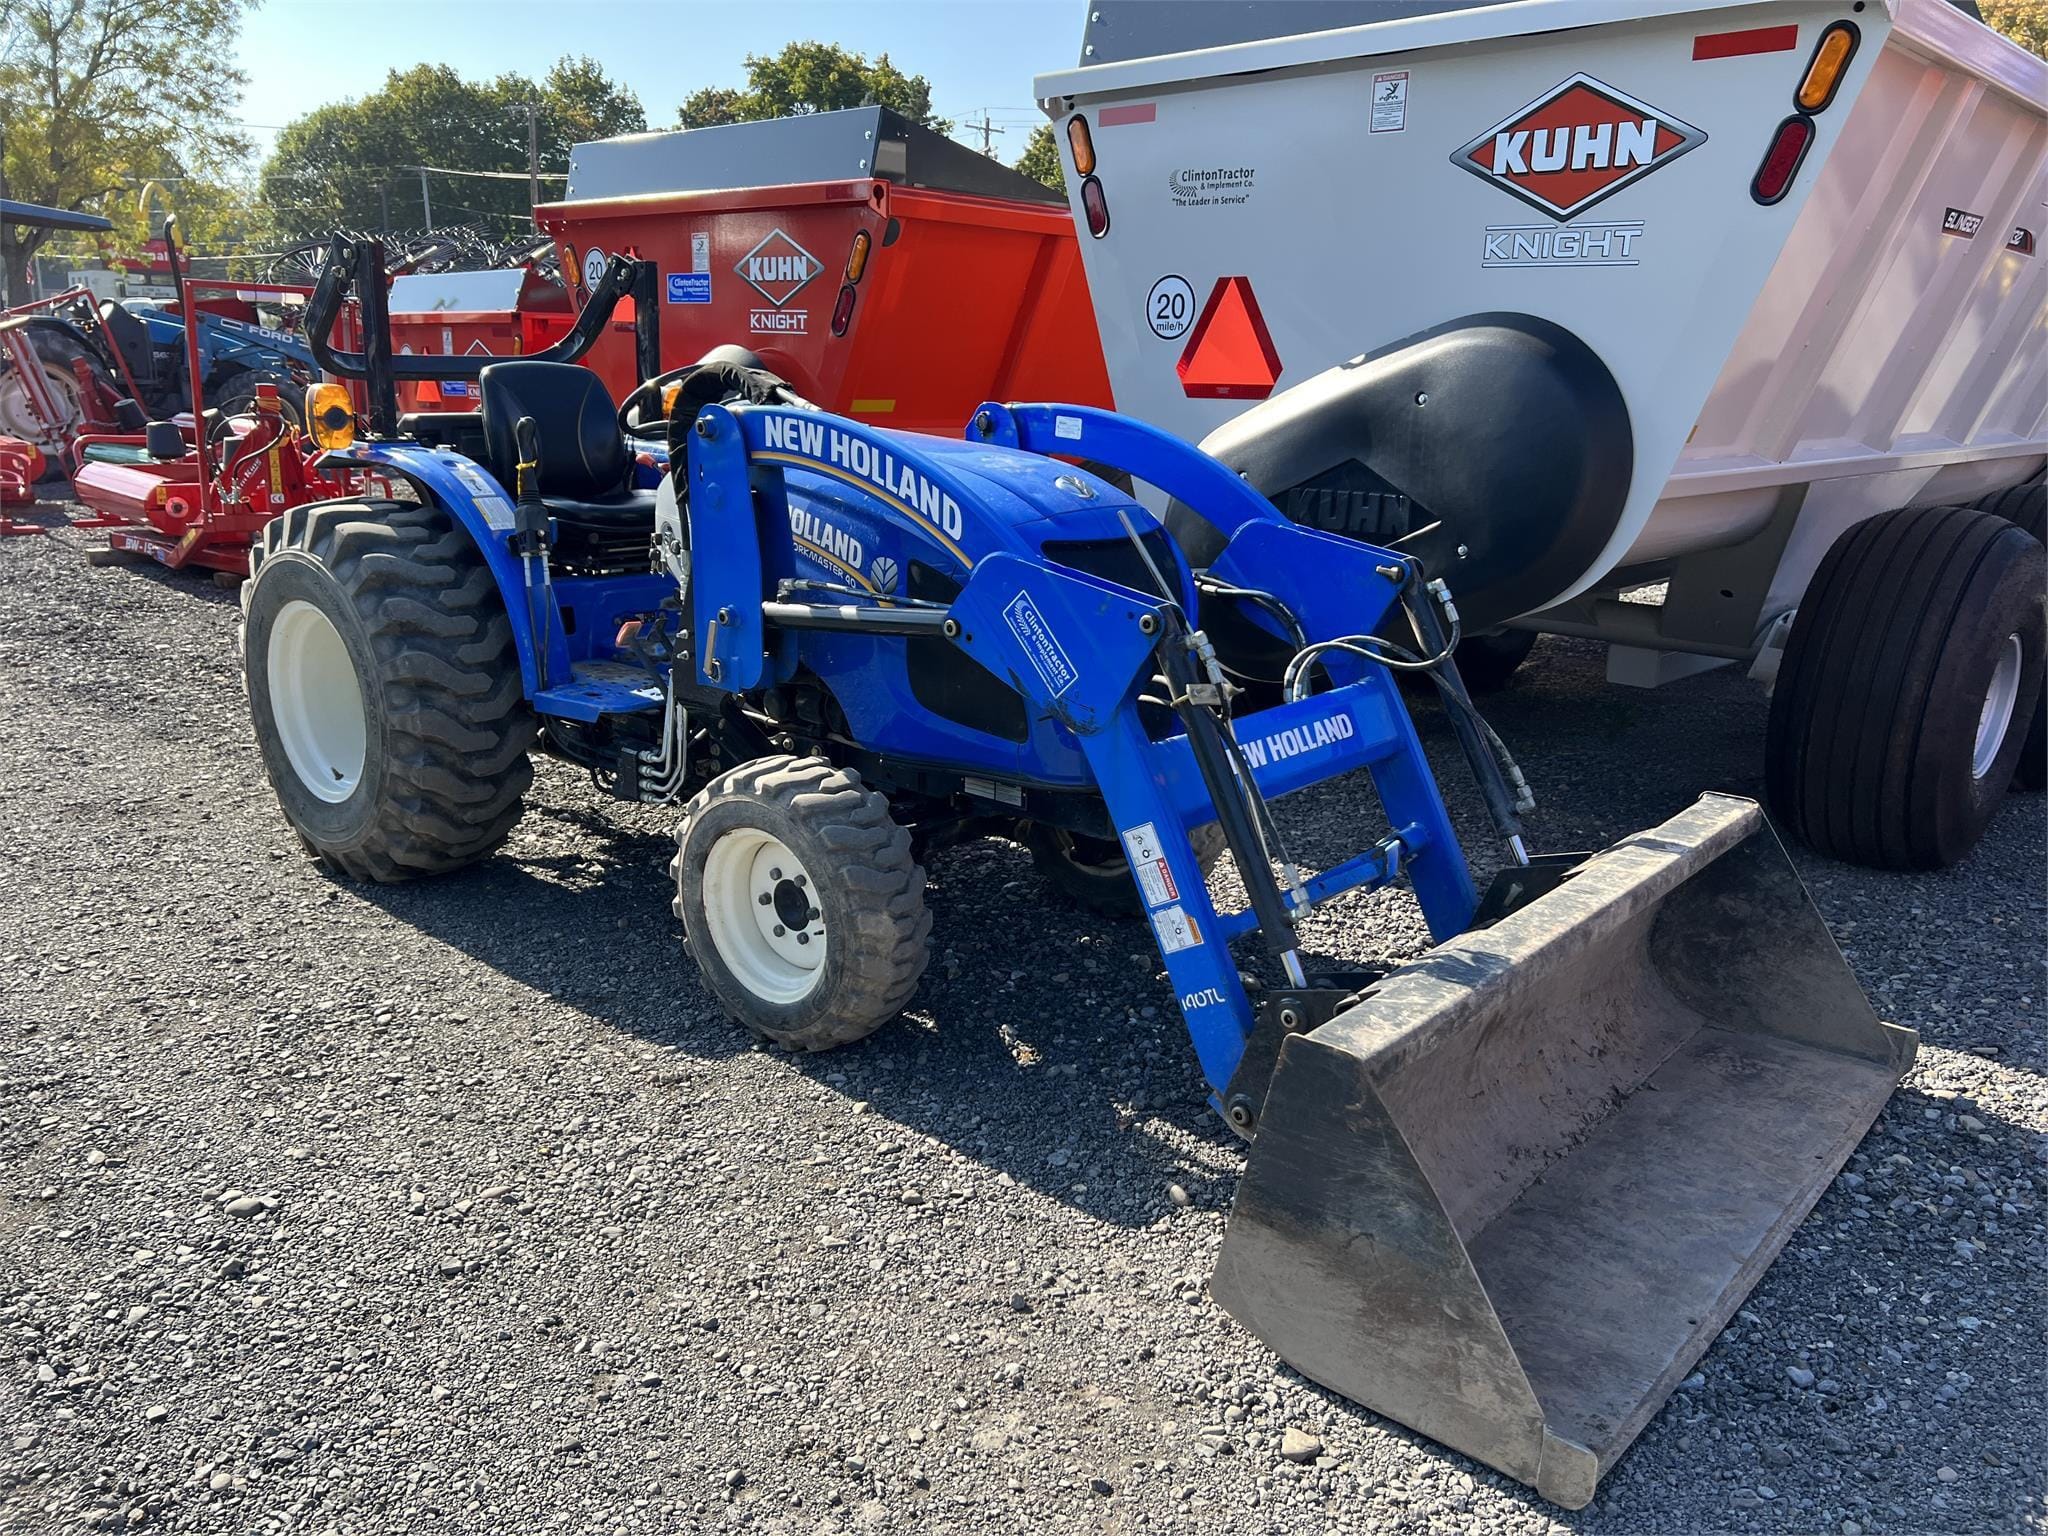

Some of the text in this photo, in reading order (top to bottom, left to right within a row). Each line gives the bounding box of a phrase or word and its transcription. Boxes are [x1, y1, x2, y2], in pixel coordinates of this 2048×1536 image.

[1492, 119, 1657, 176] KUHN
[1181, 167, 1255, 182] ClintonTractor
[1200, 182, 1206, 190] &
[1207, 181, 1242, 191] Implement
[1172, 194, 1250, 207] "The Leader in Service"
[1944, 211, 1981, 234] SLINGER
[1482, 229, 1643, 260] KNIGHT
[588, 261, 603, 280] 20
[749, 255, 808, 281] KUHN
[1156, 293, 1185, 320] 20
[750, 313, 808, 330] KNIGHT
[1156, 321, 1184, 331] mile/h
[249, 326, 293, 344] FORD
[764, 415, 963, 542] NEW HOLLAND
[1287, 487, 1412, 536] KUHN
[793, 542, 857, 589] ORKMASTER 40
[1024, 610, 1071, 682] ClintonTractor
[1266, 713, 1354, 762] HOLLAND
[1181, 987, 1226, 1012] 140TL
